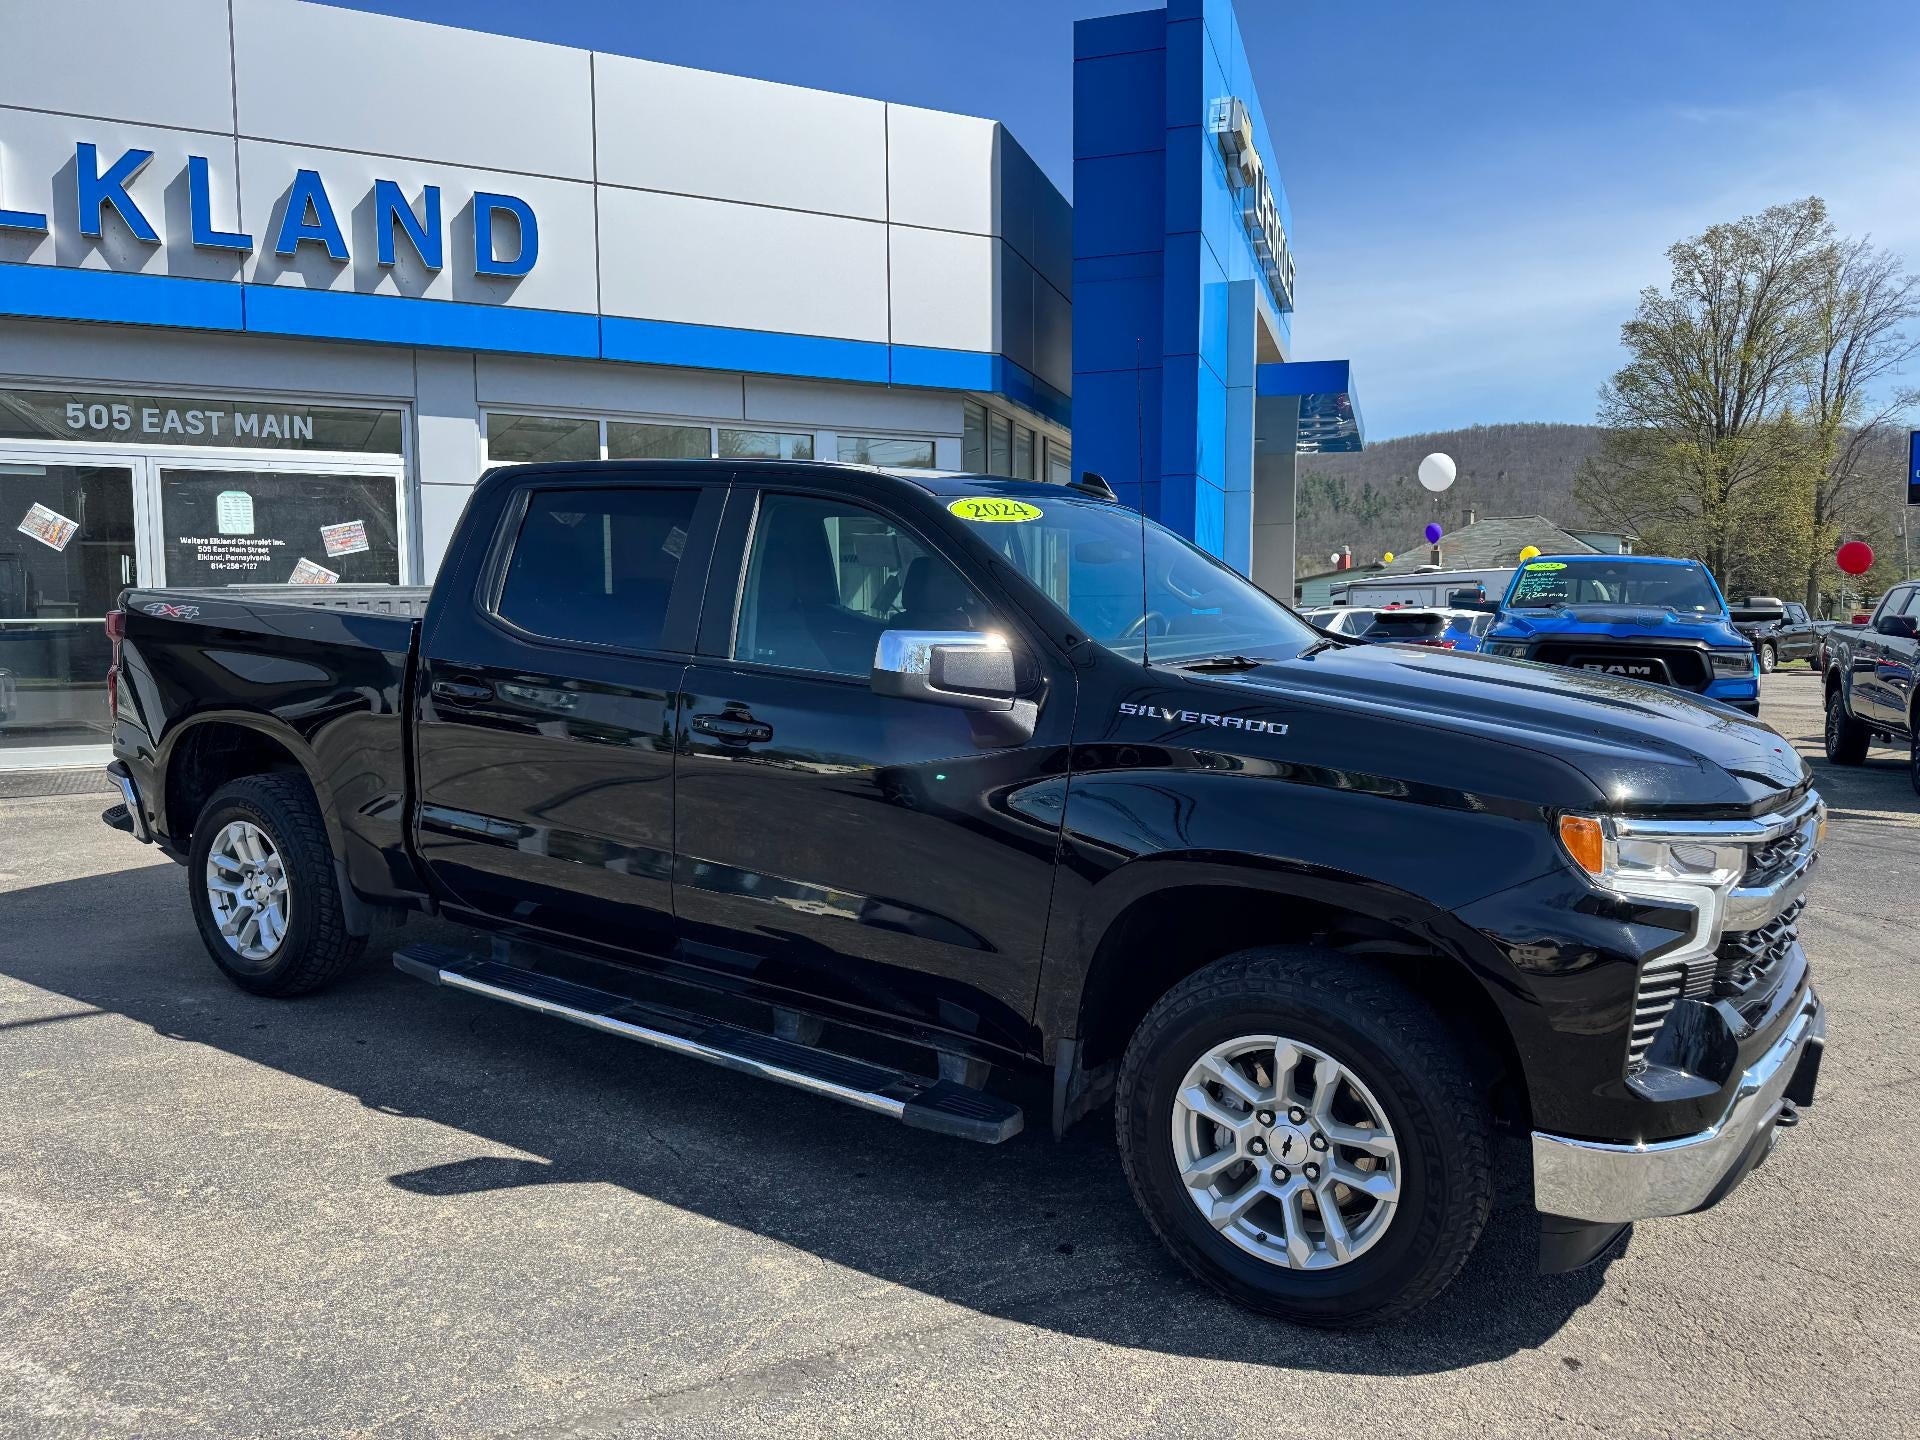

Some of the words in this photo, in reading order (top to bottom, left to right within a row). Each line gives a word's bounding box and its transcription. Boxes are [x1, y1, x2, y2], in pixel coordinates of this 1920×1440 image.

[66, 403, 131, 431] 505
[142, 407, 225, 435] EAST
[234, 412, 313, 440] MAIN
[966, 503, 1029, 517] 2024
[180, 536, 209, 544] Walters
[210, 537, 236, 545] Elkland
[237, 538, 272, 546] Chevrolet
[198, 545, 212, 553] 505
[225, 554, 271, 562] Pennsylvania
[1583, 663, 1651, 675] RAM
[1118, 702, 1289, 735] SILVERADO
